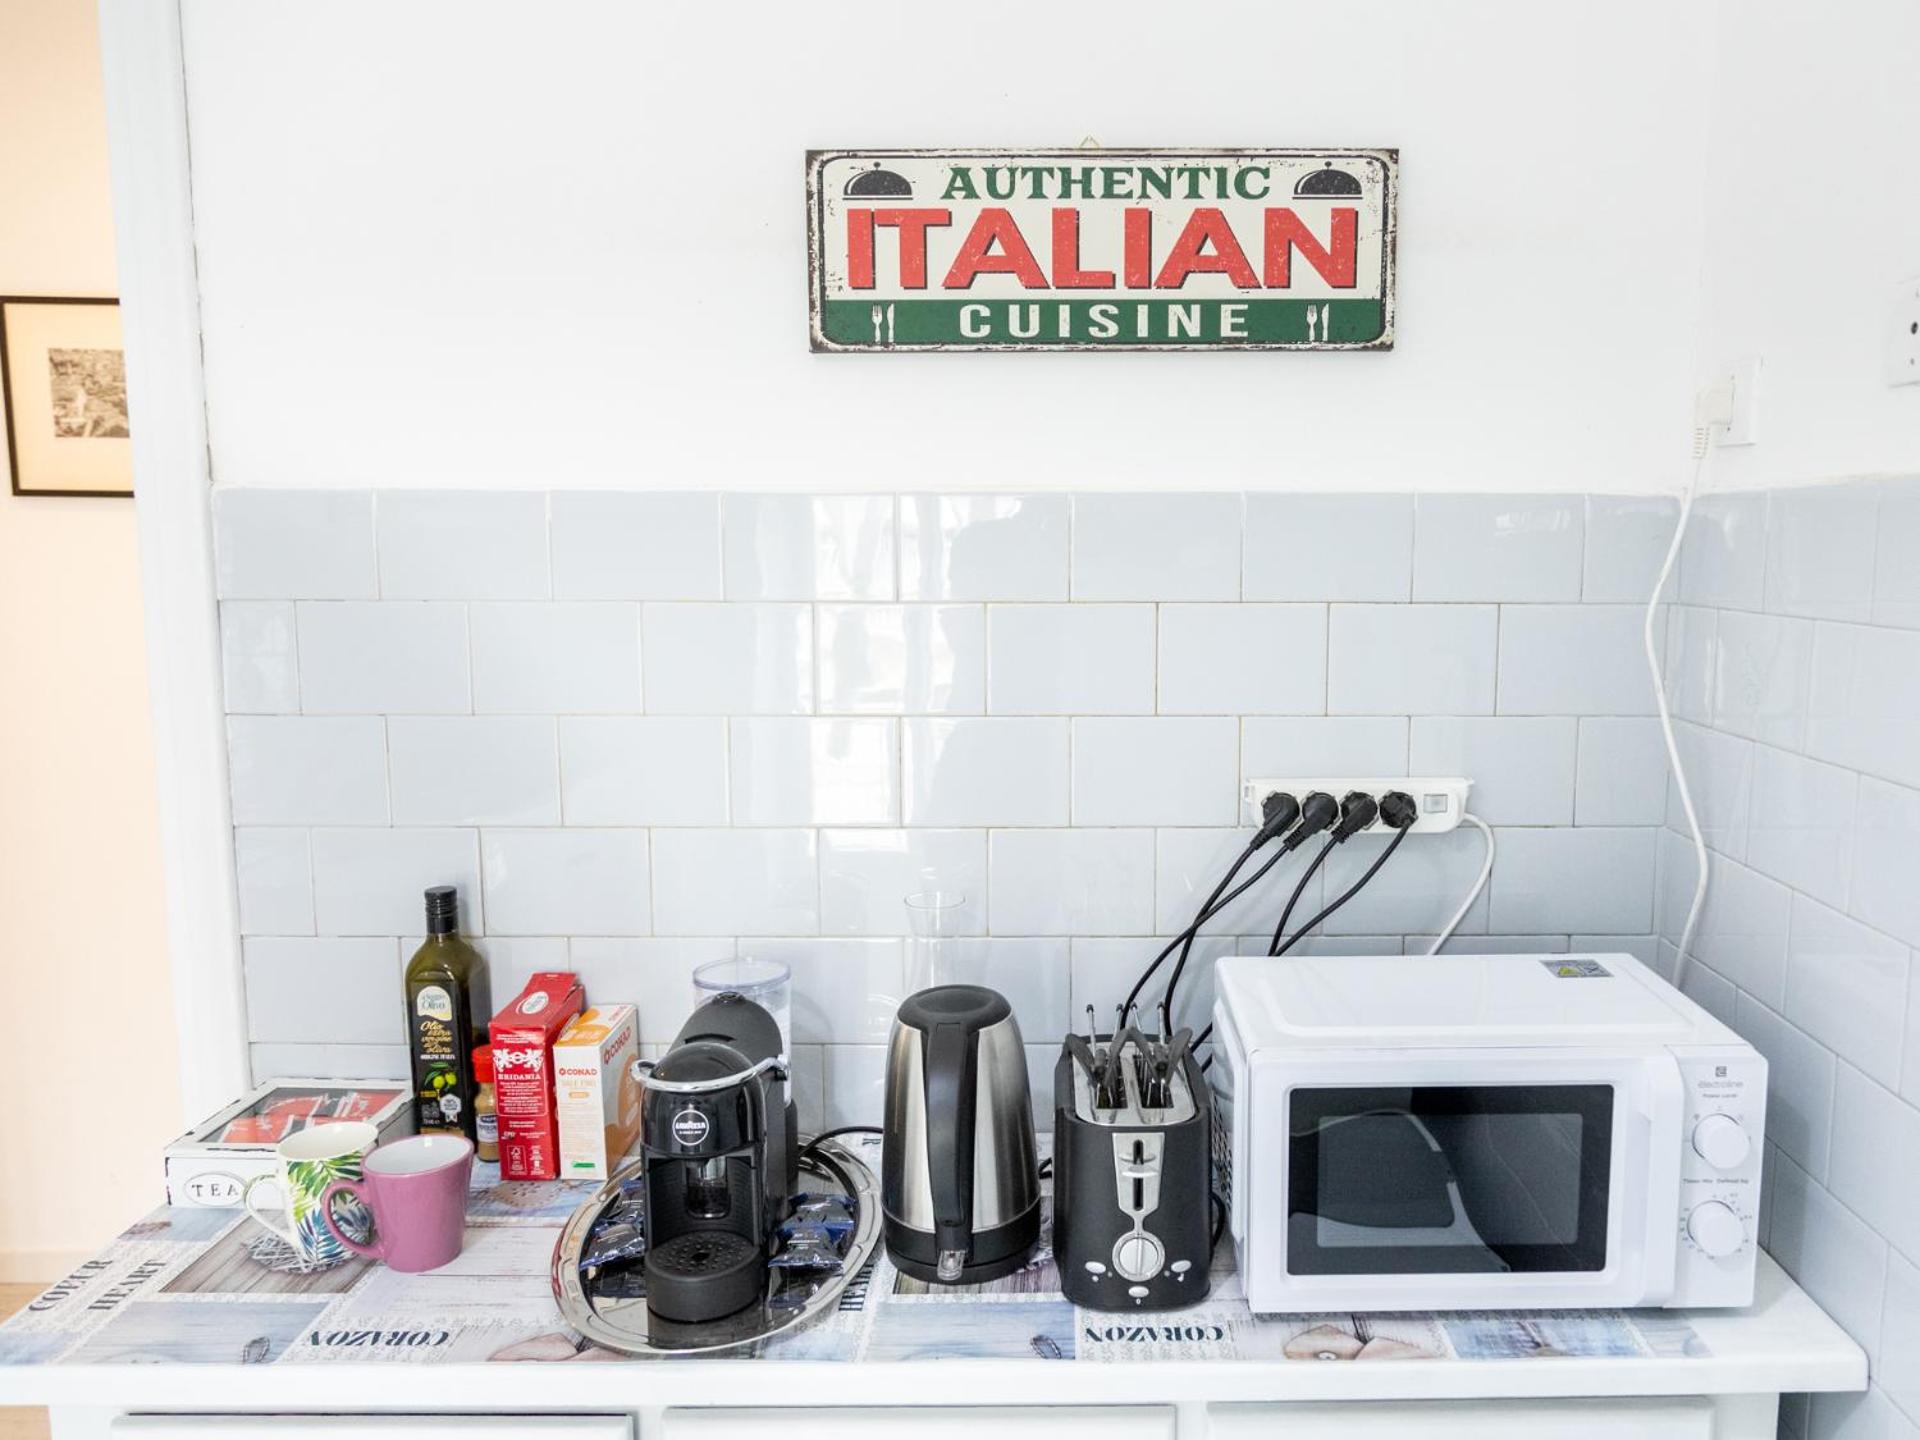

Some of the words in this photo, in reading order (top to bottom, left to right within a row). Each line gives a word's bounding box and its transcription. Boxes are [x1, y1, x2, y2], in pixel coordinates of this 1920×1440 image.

[942, 167, 1270, 200] AUTHENTIC
[847, 207, 1358, 289] ITALIAN
[959, 303, 1249, 338] CUISINE
[566, 1068, 598, 1076] CONAD
[191, 1183, 239, 1198] TEA
[28, 1259, 114, 1312] COEUR
[87, 1258, 167, 1310] HEART
[309, 1330, 450, 1347] CORAZON
[1086, 1325, 1225, 1343] CORAZON
